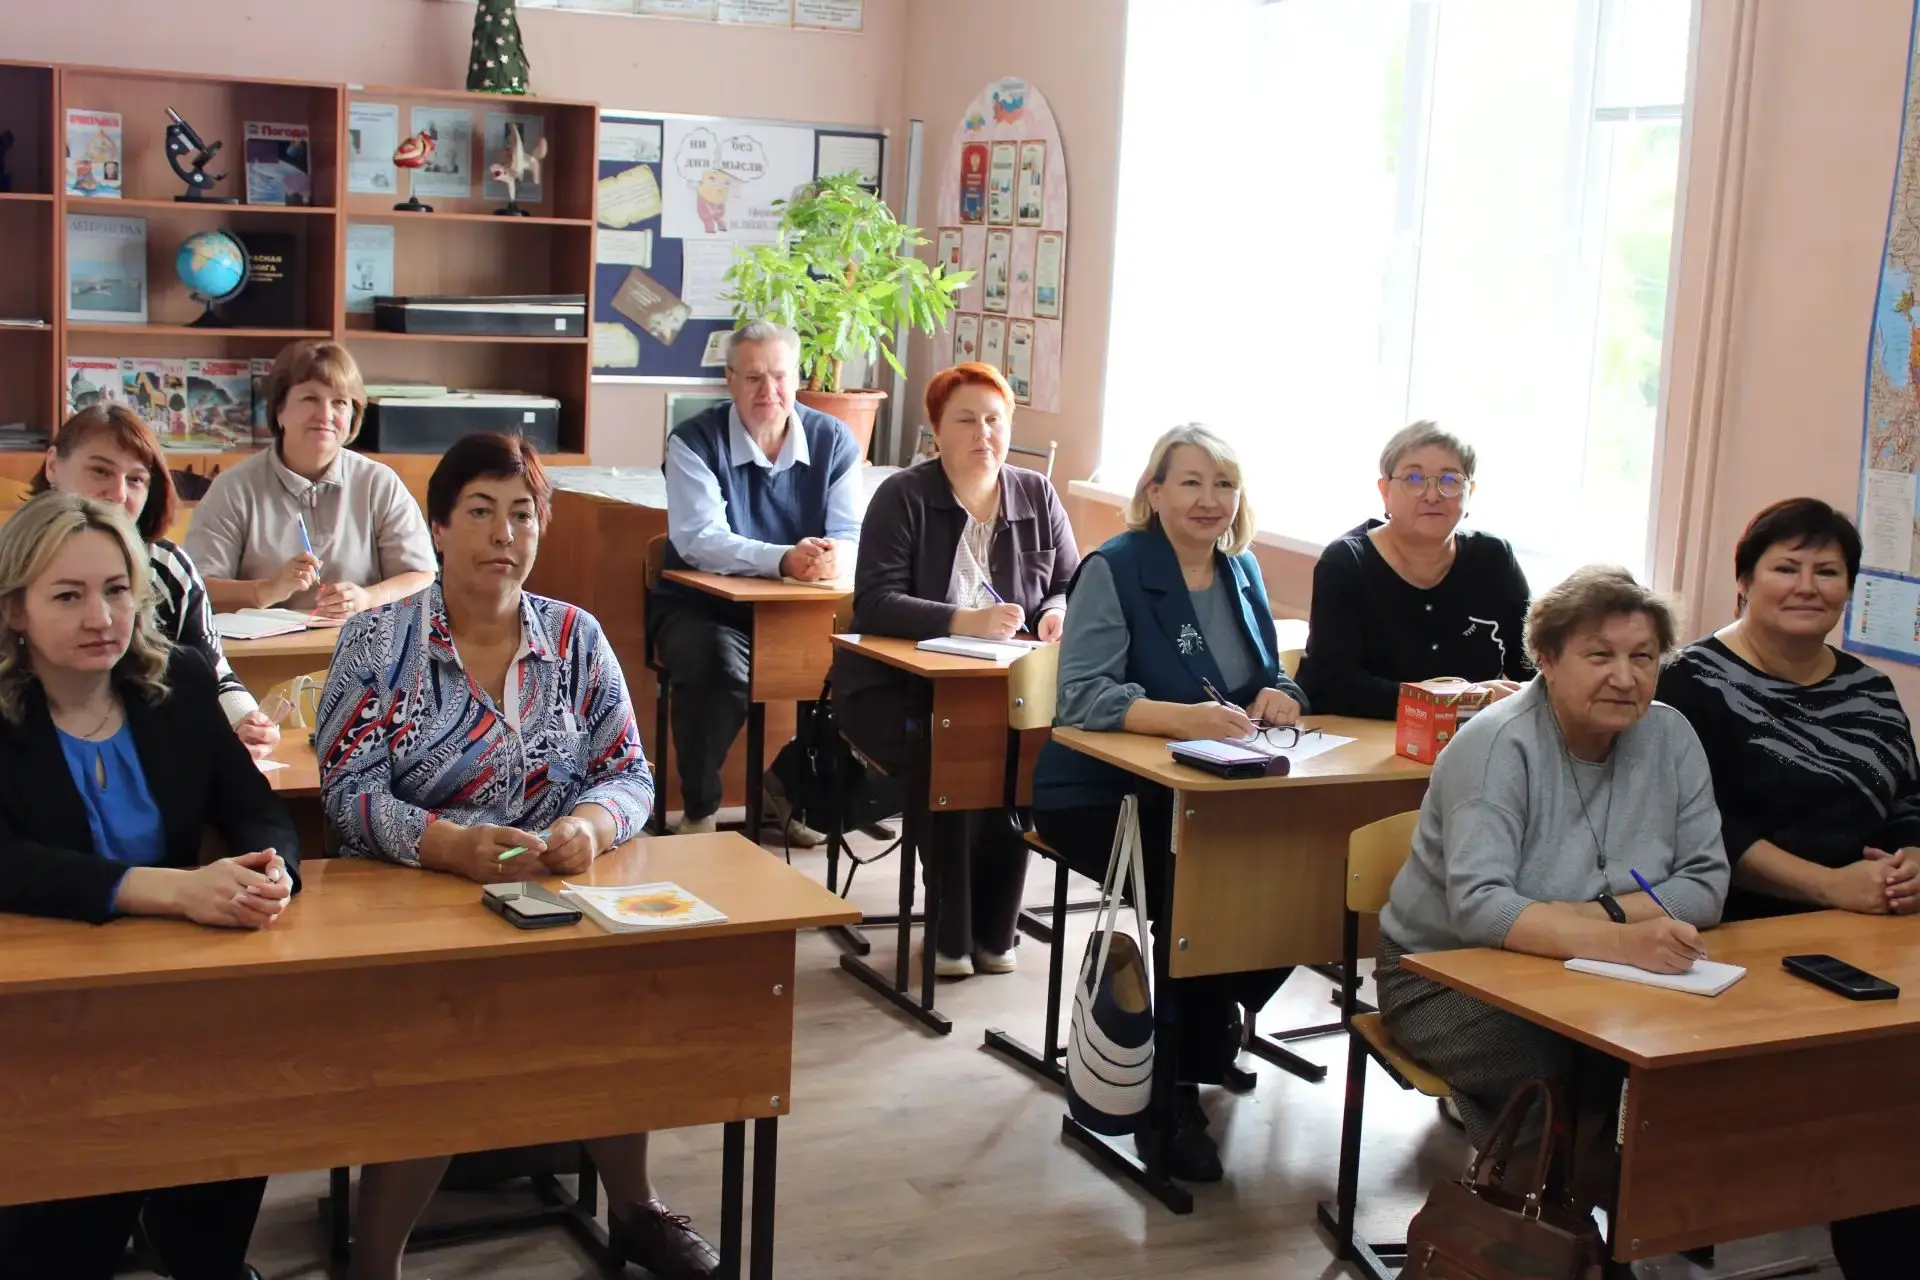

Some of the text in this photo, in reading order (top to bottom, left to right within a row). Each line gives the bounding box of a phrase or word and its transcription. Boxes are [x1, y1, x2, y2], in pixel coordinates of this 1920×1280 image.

[262, 125, 308, 138] Погода
[732, 136, 753, 152] без
[721, 160, 763, 172] мысли
[249, 264, 276, 272] НИГА
